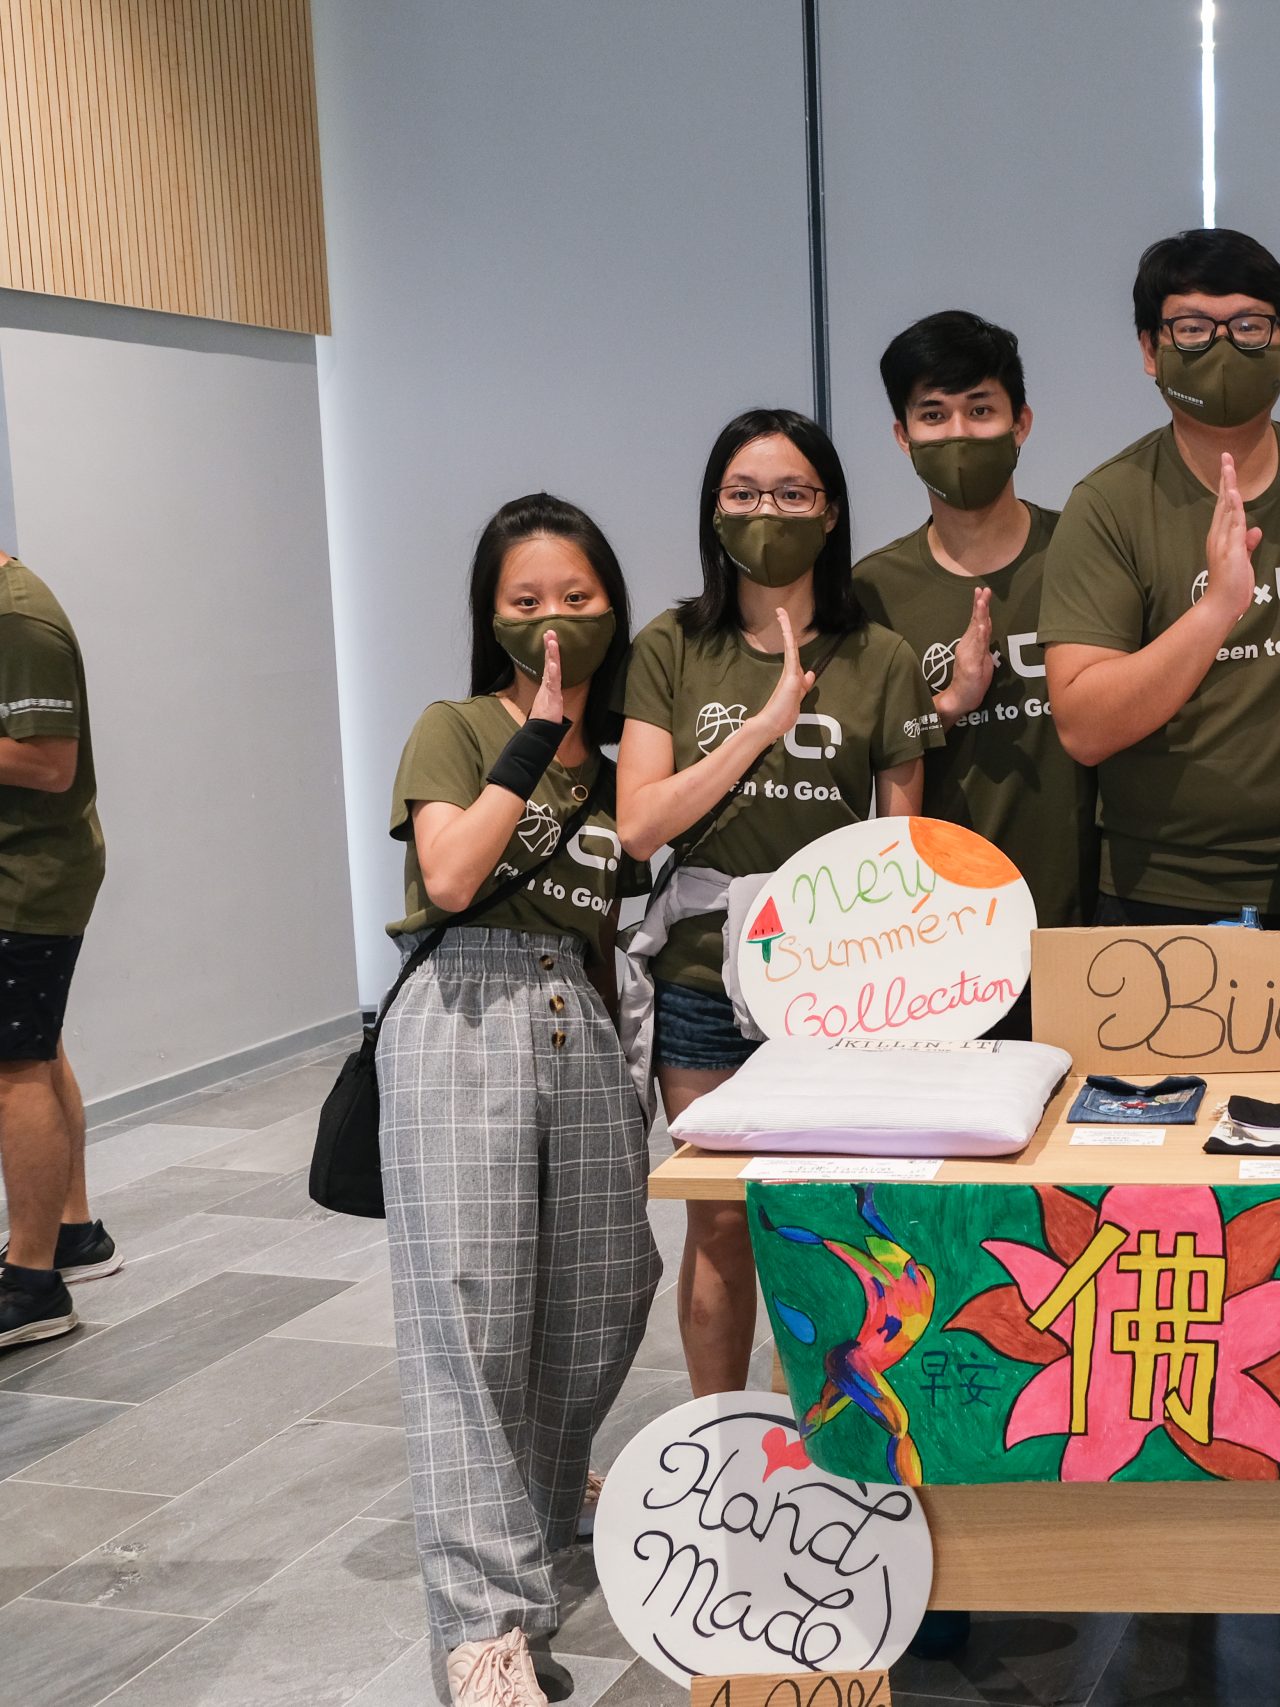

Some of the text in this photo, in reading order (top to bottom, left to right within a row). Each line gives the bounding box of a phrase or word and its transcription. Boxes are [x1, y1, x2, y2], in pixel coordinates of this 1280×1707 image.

[1215, 643, 1259, 662] een
[994, 702, 1019, 721] to
[764, 779, 789, 799] to
[793, 780, 842, 801] Goa
[542, 878, 566, 900] to
[1028, 1221, 1227, 1444] 佛
[919, 1349, 1002, 1408] 早安
[642, 1441, 914, 1577] Hand
